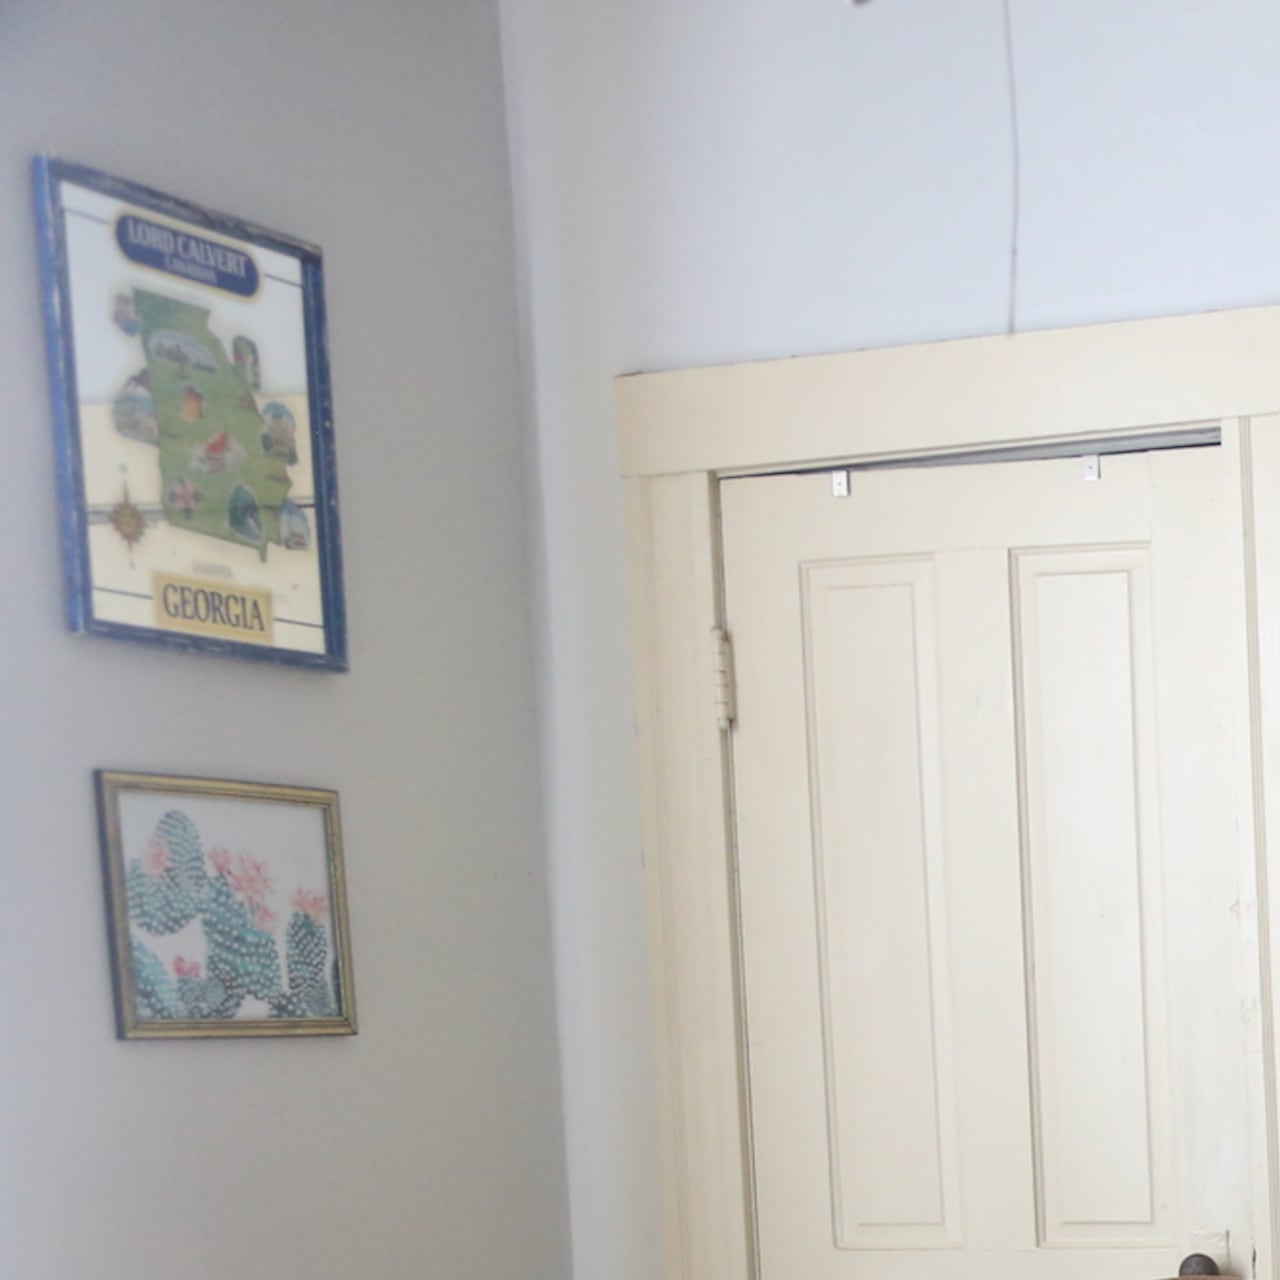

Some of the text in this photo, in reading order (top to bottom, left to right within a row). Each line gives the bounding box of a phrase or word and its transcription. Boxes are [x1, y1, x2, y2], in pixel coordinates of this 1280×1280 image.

[127, 217, 248, 278] LORD CALVERT
[163, 583, 265, 631] GEORGIA
